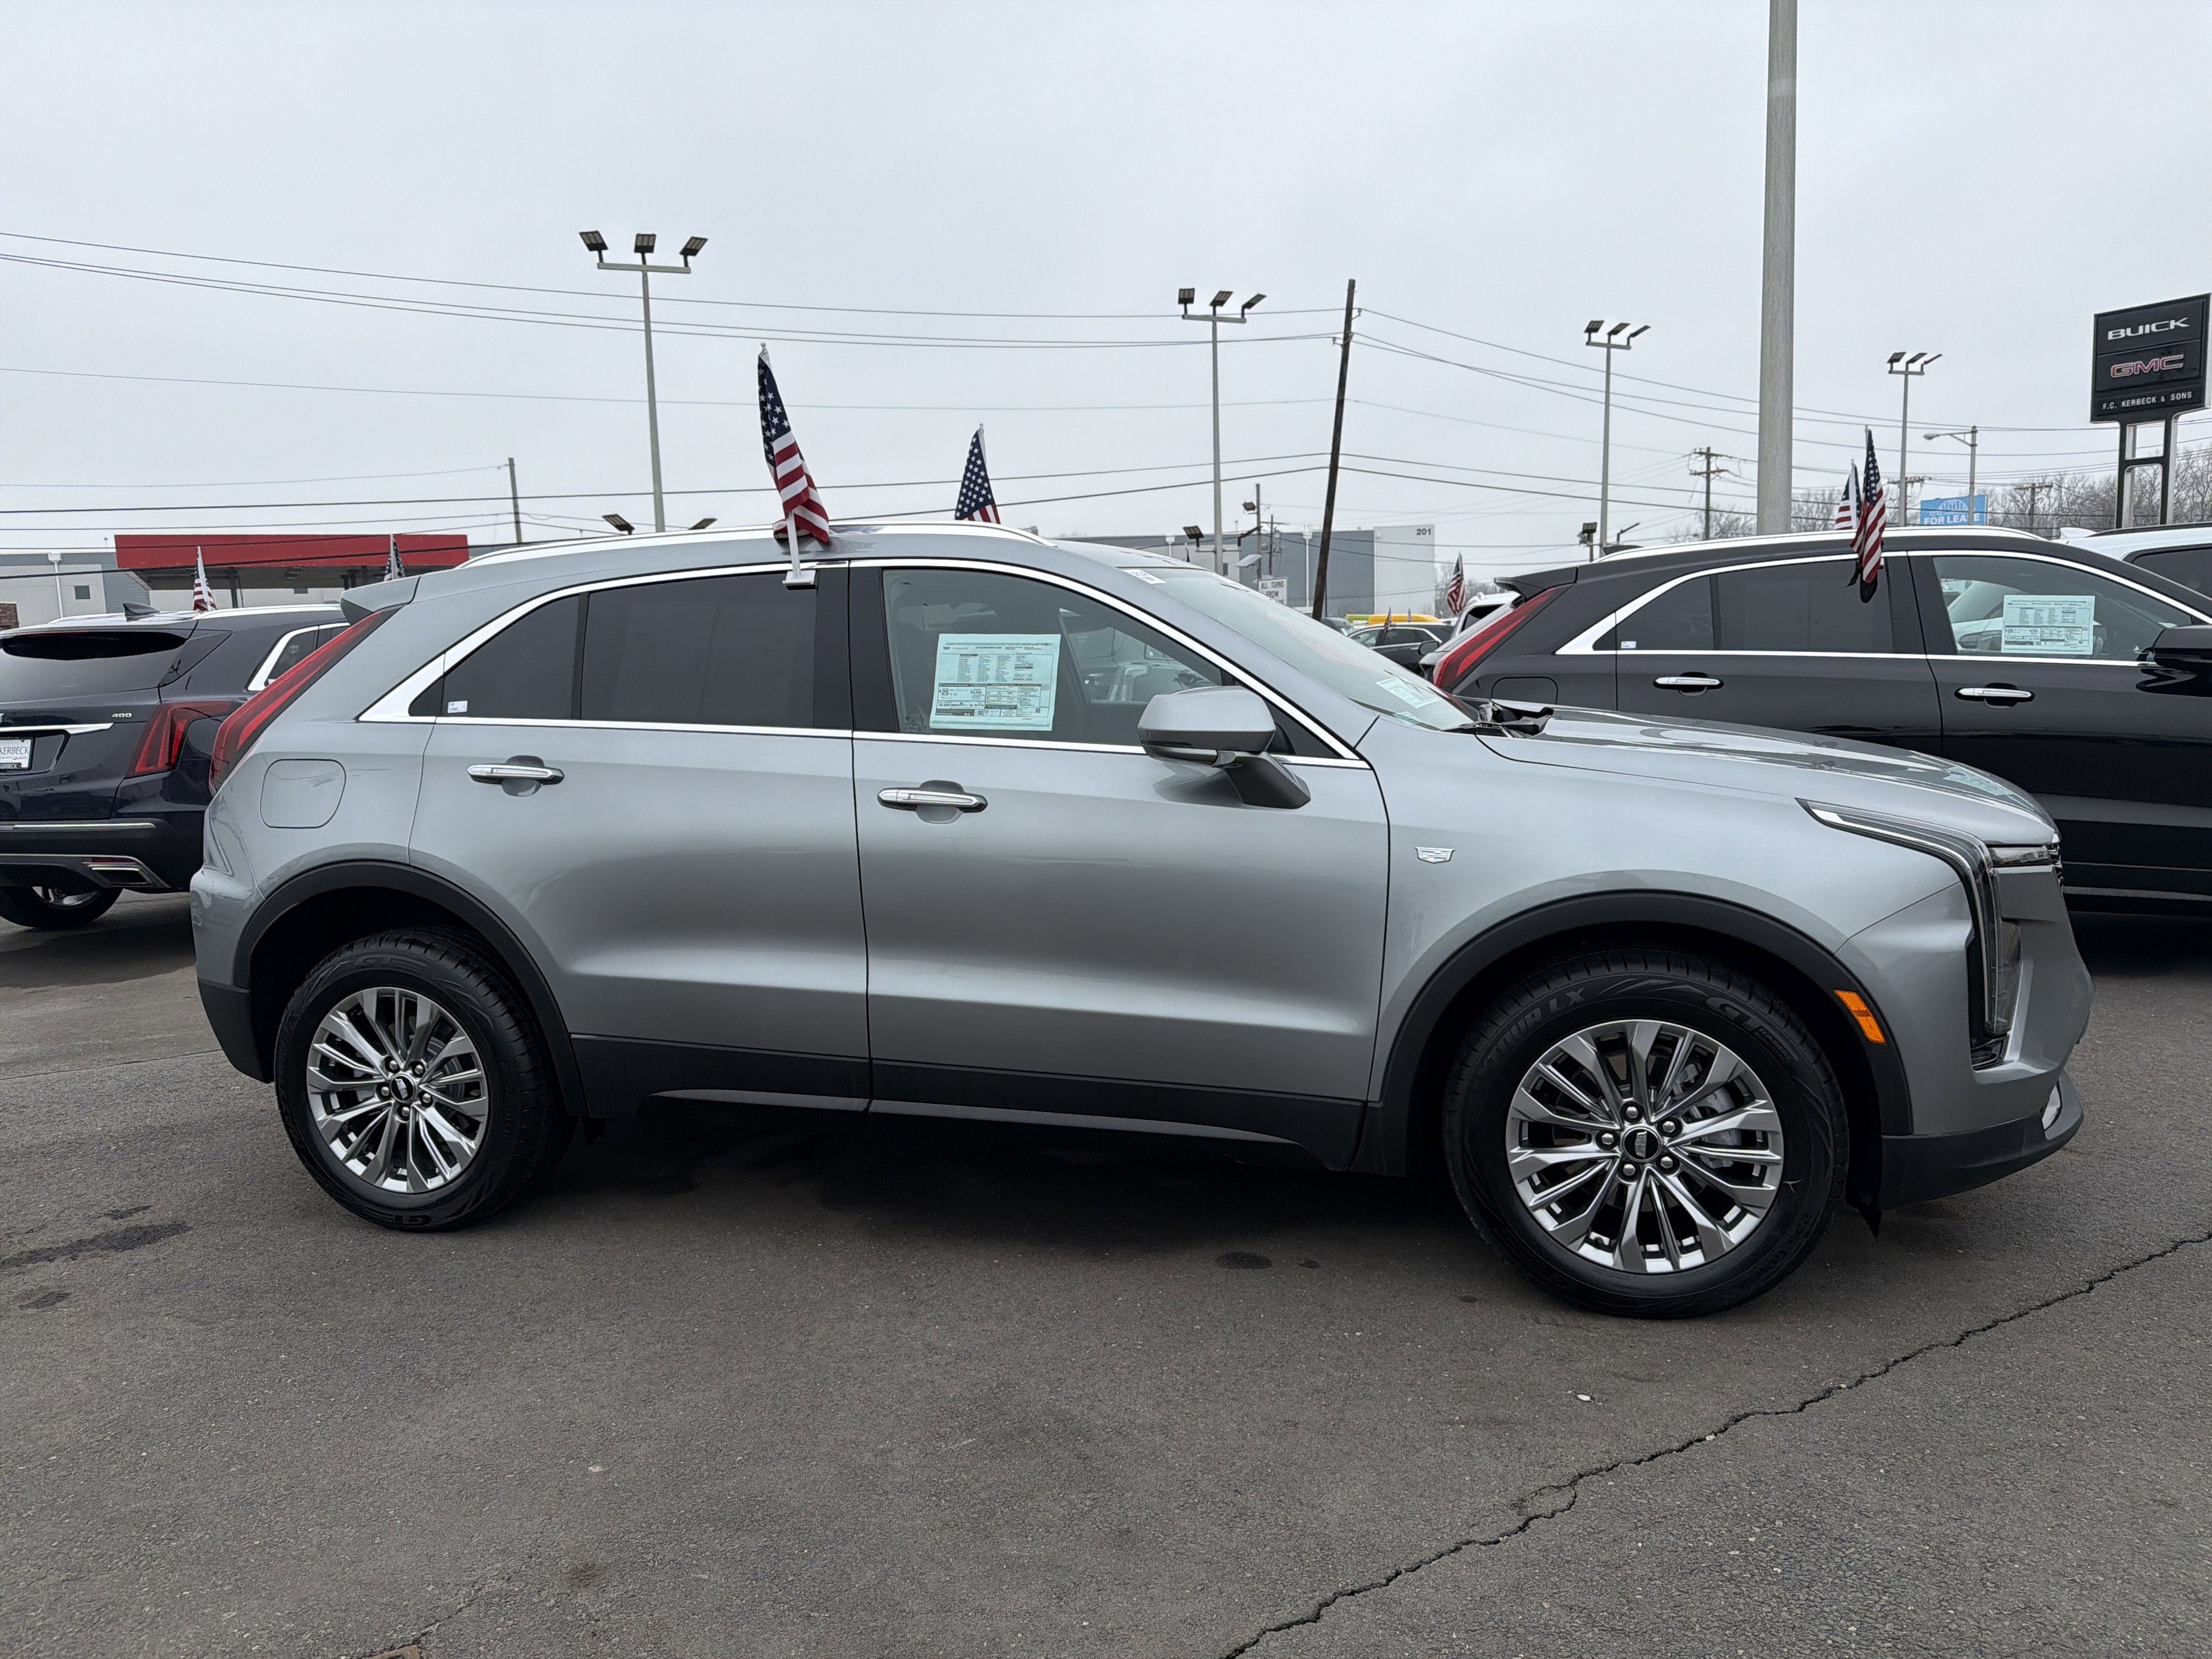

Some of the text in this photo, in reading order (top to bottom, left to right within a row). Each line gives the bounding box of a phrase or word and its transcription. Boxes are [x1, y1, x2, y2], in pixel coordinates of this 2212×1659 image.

[2108, 317, 2190, 340] BUICK
[2111, 354, 2184, 378] GMC
[2103, 402, 2117, 410] F.C.
[2121, 397, 2157, 408] KERBECK
[2170, 391, 2192, 401] SONS
[1924, 516, 1945, 525] FOR
[1947, 513, 1980, 523] LEAE
[1416, 528, 1431, 536] 201
[0, 746, 30, 755] KERBECK
